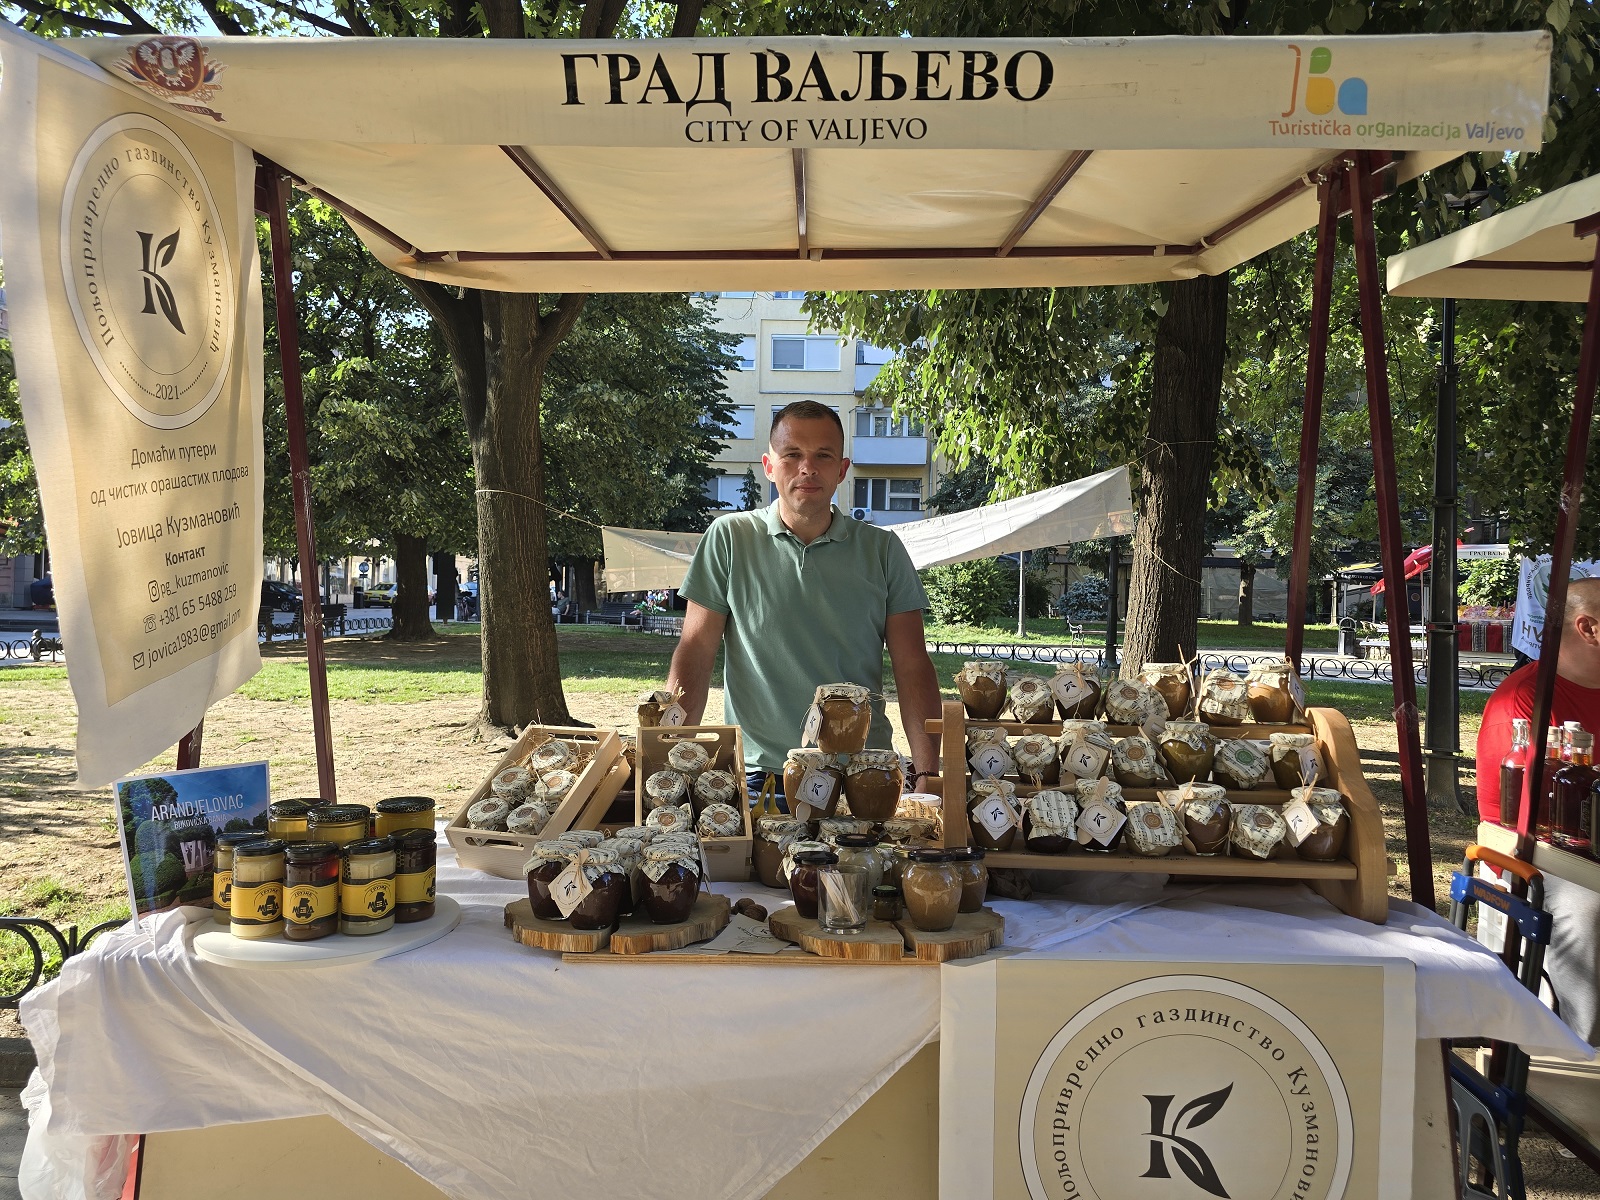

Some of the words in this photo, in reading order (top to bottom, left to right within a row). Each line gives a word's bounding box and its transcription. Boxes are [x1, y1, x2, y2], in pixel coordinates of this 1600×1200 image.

[560, 51, 733, 117] ГРАД
[749, 48, 1055, 103] ВАЉЕВО
[684, 119, 752, 143] CITY
[761, 119, 799, 142] OF
[807, 117, 928, 146] VALJEVO
[1268, 119, 1351, 136] Turistička
[1465, 121, 1525, 143] Valjevo
[82, 158, 120, 348] Пољопривредно
[126, 146, 202, 213] газдинство
[201, 218, 222, 355] Кузмановић
[155, 384, 180, 400] 2021
[131, 444, 177, 469] Домаћи
[178, 443, 218, 466] путери
[90, 489, 107, 506] од
[108, 483, 148, 501] чистих
[150, 473, 211, 496] орашастих
[212, 464, 249, 484] плодова
[116, 522, 163, 549] Јовица
[165, 501, 241, 538] Кузмановић
[165, 545, 206, 567] Контакт
[160, 561, 230, 598] pg_kuzmanovic
[159, 605, 180, 626] +381
[182, 600, 196, 617] 65
[198, 590, 223, 611] 5488
[224, 583, 237, 602] 259
[148, 607, 242, 669] jovica1983@gmail.com
[151, 793, 244, 822] ARANDJELOVAC
[1135, 1006, 1287, 1063] газдинство
